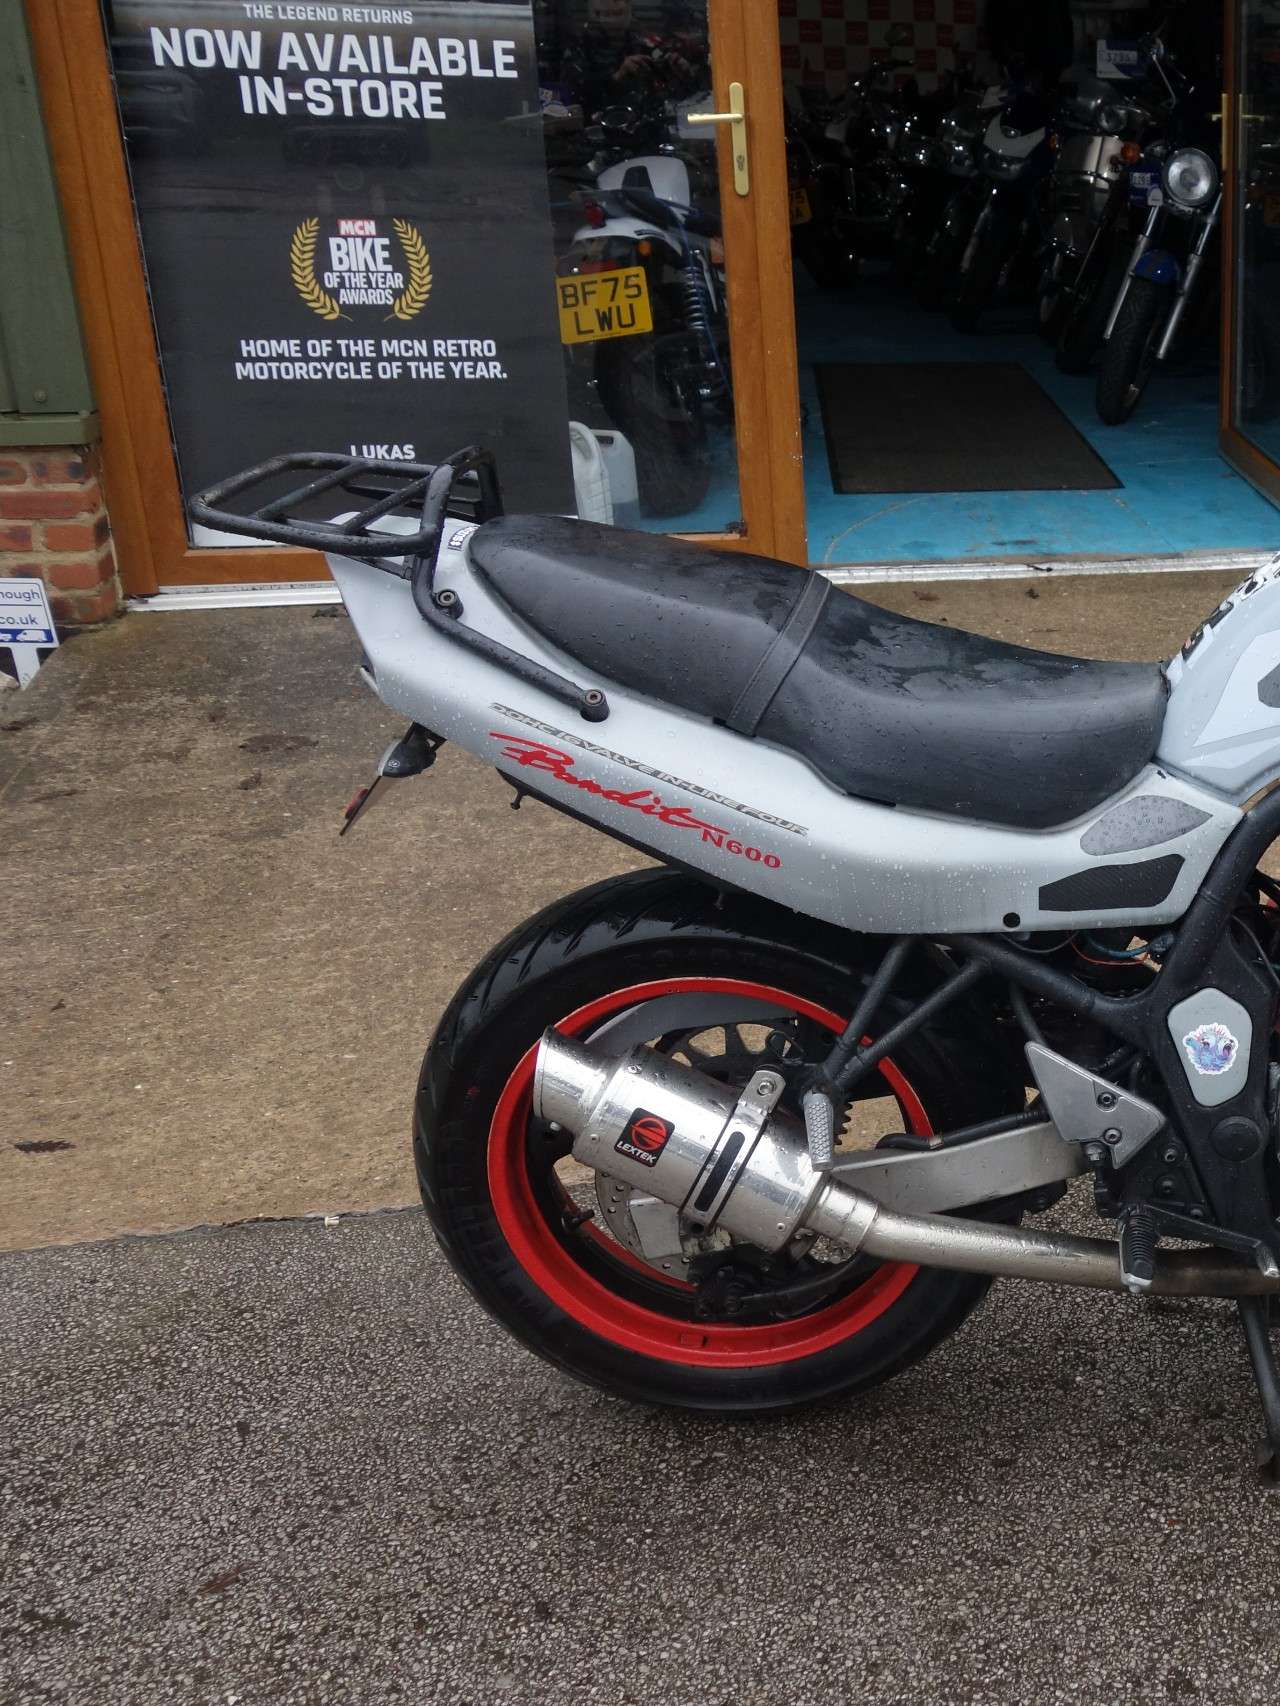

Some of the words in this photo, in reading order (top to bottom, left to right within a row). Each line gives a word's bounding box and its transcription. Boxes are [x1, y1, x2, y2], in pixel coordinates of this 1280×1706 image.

[243, 3, 274, 19] THE
[278, 5, 338, 22] LEGEND
[343, 7, 414, 25] RETURNS
[150, 27, 262, 70] NOW
[278, 32, 519, 78] AVAILABLE
[239, 75, 447, 119] IN-STORE
[340, 220, 376, 235] MCN
[328, 237, 393, 272] BIKE
[323, 272, 341, 289] OF
[341, 272, 369, 289] THE
[368, 272, 404, 289] YEAR
[560, 273, 642, 309] BF75
[339, 289, 395, 305] AWARDS
[574, 303, 636, 336] LWU
[240, 339, 302, 358] HOME
[306, 339, 332, 357] OF
[336, 339, 376, 358] THE
[382, 339, 428, 357] MCN
[433, 339, 497, 357] RETRO
[235, 361, 373, 380] MOTORCYCLE
[378, 361, 402, 379] OF
[407, 361, 446, 379] THE
[449, 361, 508, 379] YEAR.
[350, 444, 416, 460] LUKAS
[490, 702, 556, 736] DOHC
[489, 731, 731, 836] Bandit
[701, 829, 782, 869] N600
[616, 1140, 657, 1164] LEXTEK
